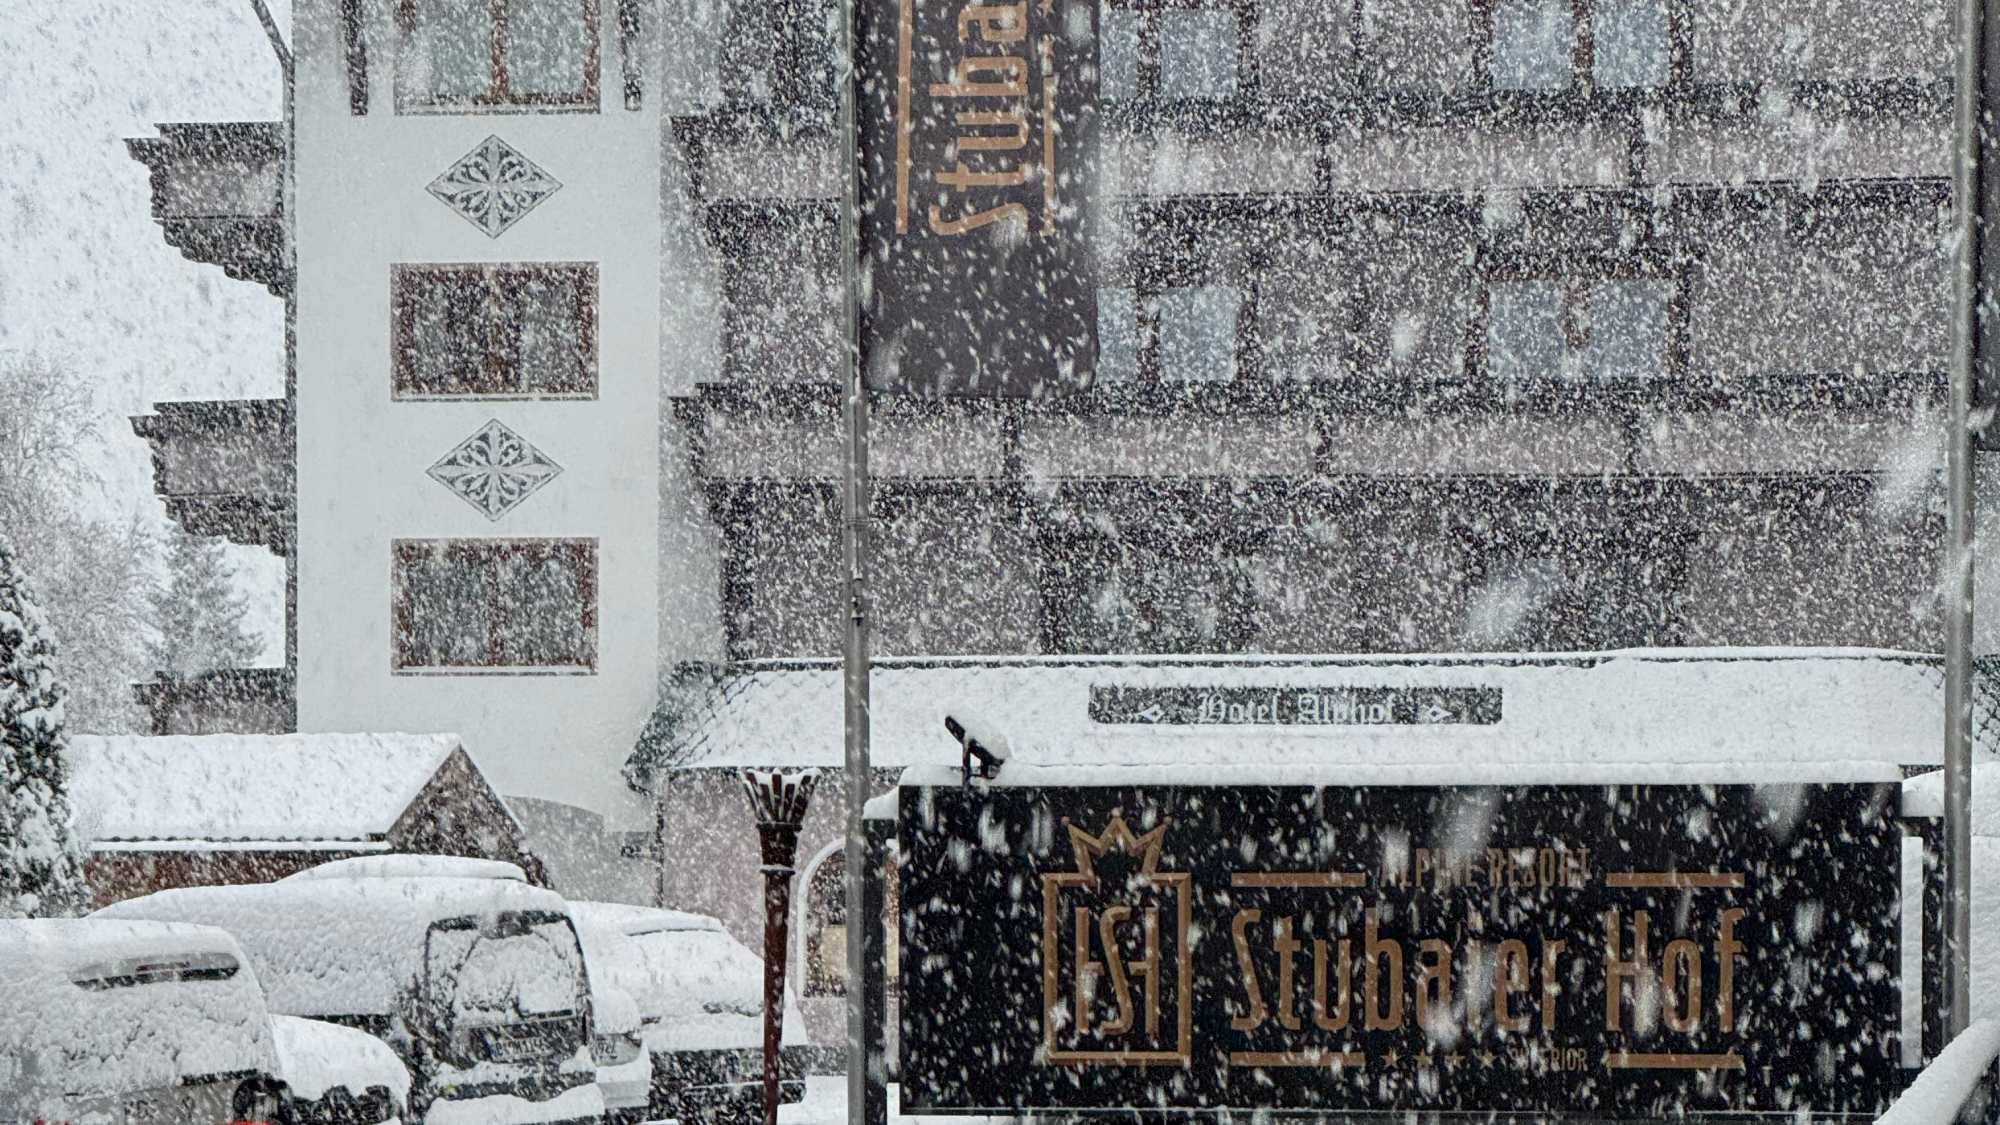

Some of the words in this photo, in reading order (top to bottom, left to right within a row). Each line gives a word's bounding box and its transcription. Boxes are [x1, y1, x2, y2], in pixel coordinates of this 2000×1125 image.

[1197, 692, 1281, 725] Hotel
[1489, 848, 1591, 887] RESORT
[1231, 907, 1566, 1031] Stubaier
[1606, 907, 1746, 1032] Hof
